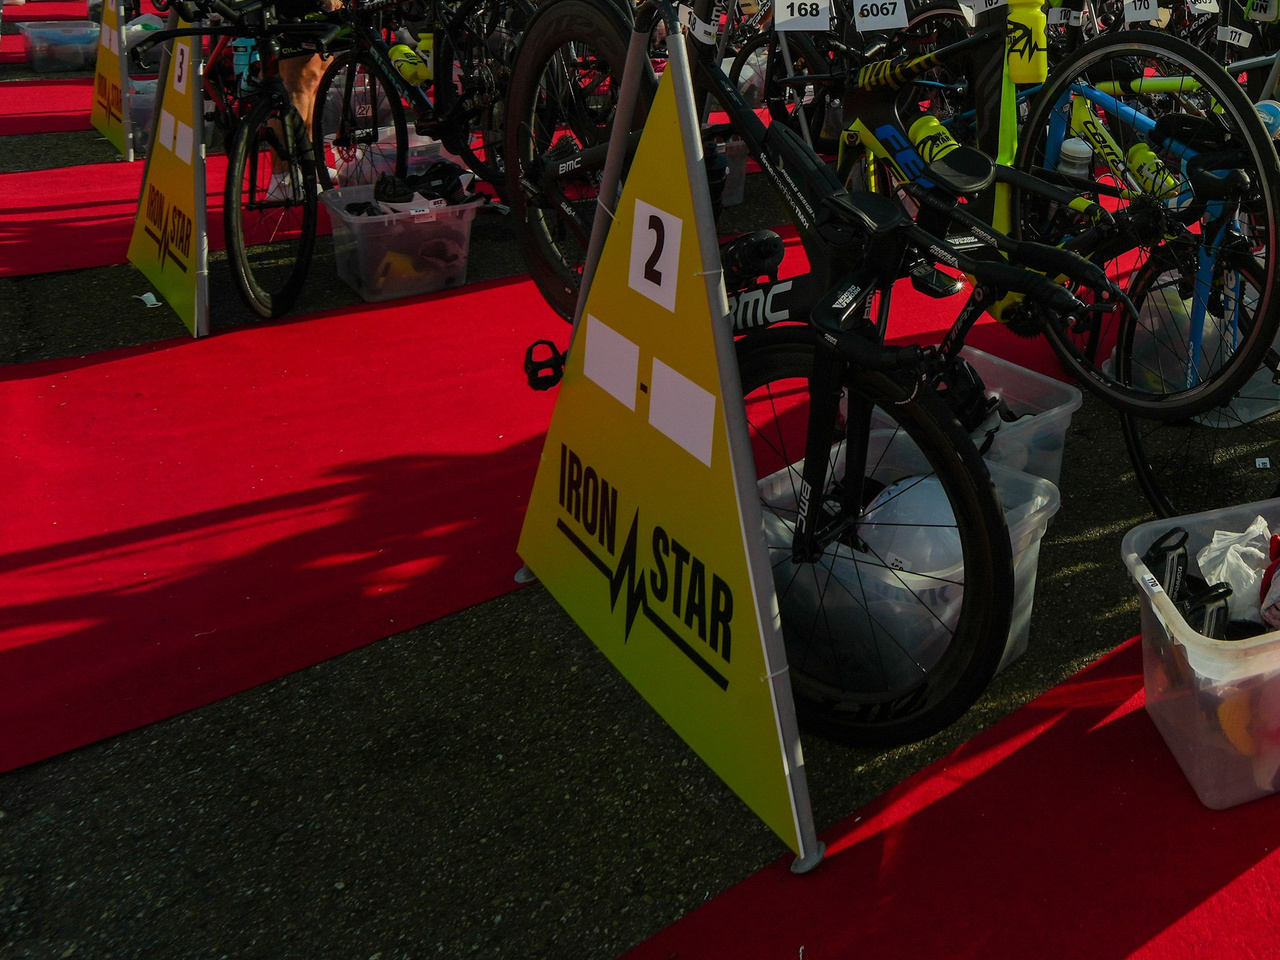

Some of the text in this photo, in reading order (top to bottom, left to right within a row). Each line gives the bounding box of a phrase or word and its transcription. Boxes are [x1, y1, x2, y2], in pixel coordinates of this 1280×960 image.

[785, 2, 820, 17] 168
[860, 2, 898, 17] 6067
[1132, 0, 1150, 11] 170
[1229, 30, 1242, 43] 171
[177, 47, 185, 84] 3
[558, 157, 582, 175] BMC
[781, 168, 815, 215] PROFILE DESIGN
[145, 182, 192, 259] IRON STAR
[643, 214, 665, 287] 2
[798, 481, 813, 534] BMC
[558, 442, 734, 665] IRON STAR
[1146, 577, 1159, 588] 170
